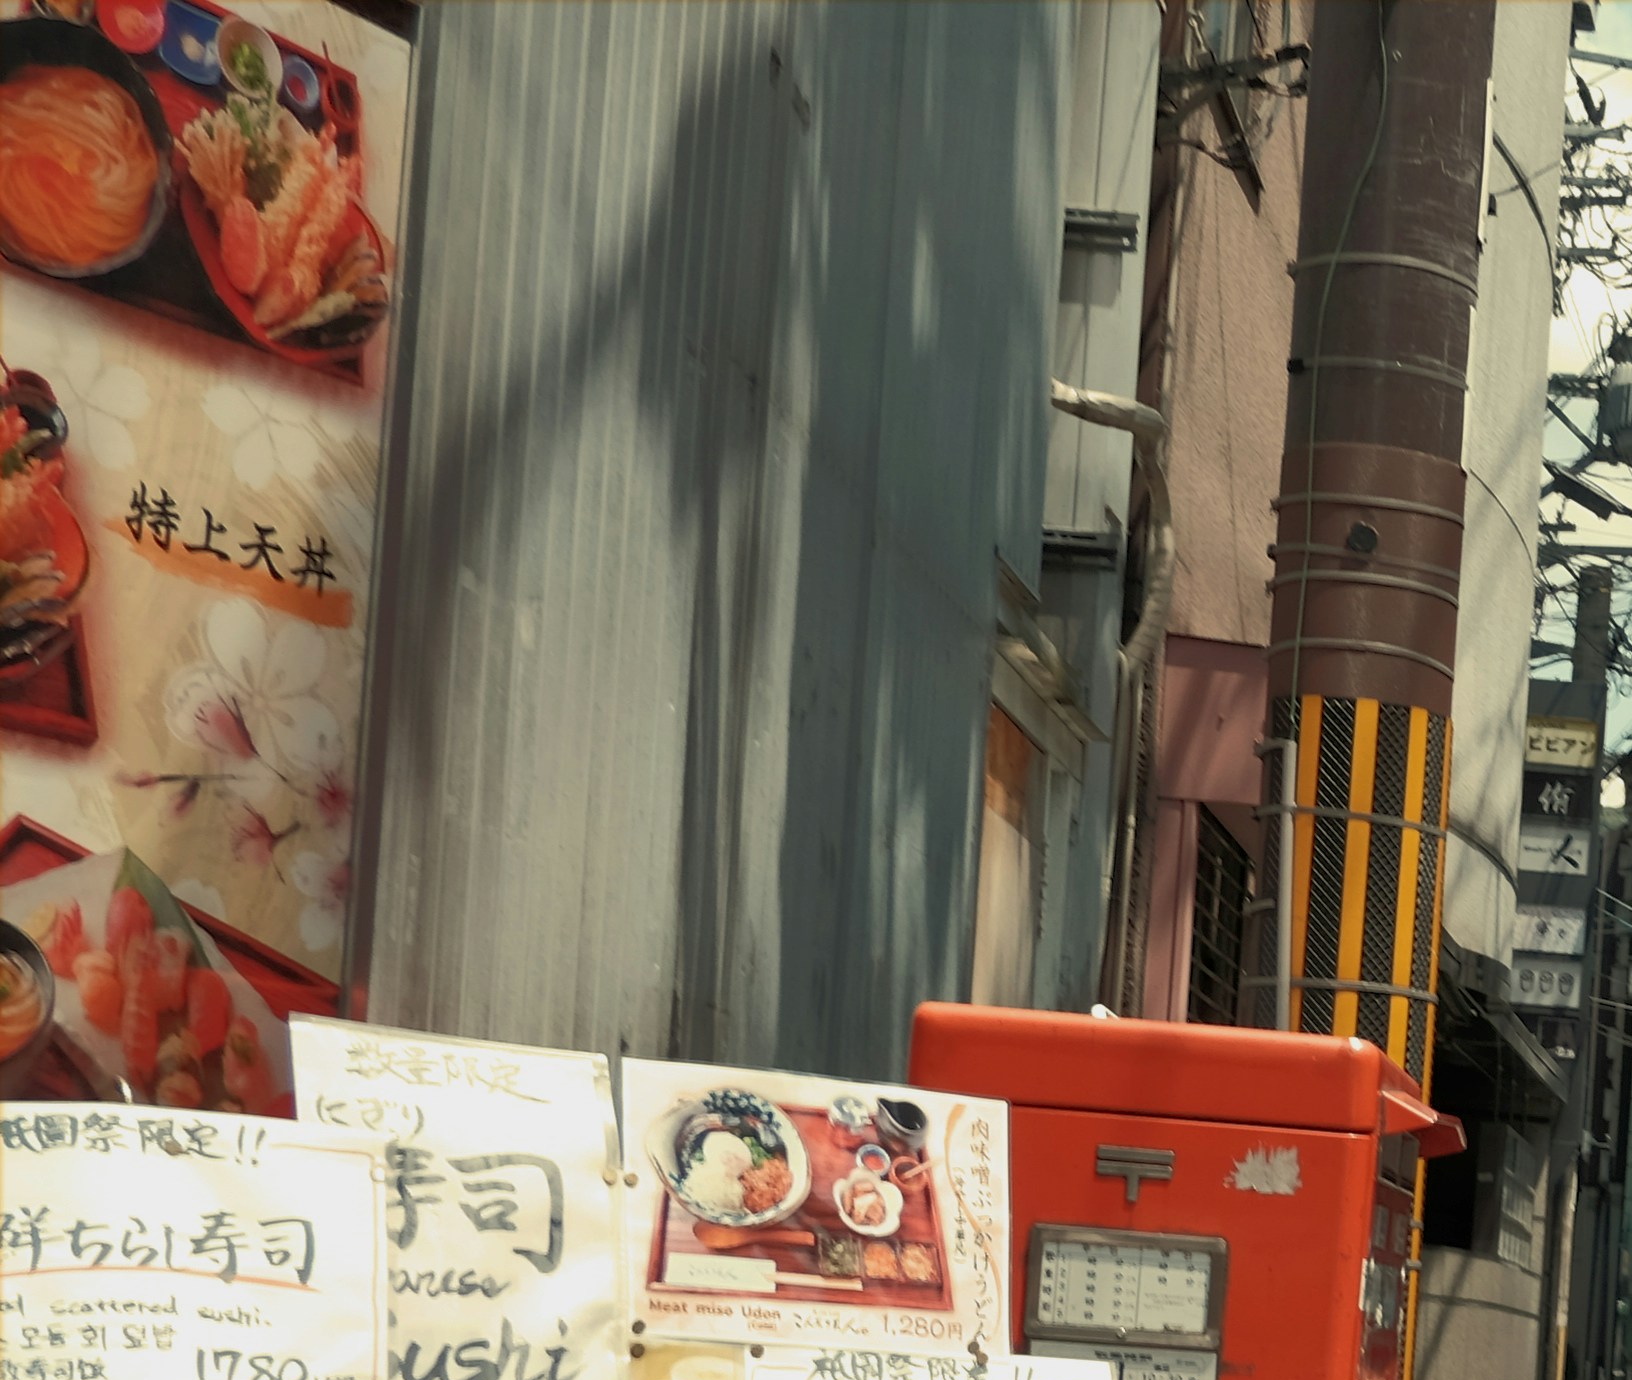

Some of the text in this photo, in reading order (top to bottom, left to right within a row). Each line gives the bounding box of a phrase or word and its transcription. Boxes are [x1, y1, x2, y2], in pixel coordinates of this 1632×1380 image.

[126, 481, 339, 593] 特上天丼
[648, 1299, 782, 1322] Meat miso Udon
[881, 1313, 963, 1342] 1,280円
